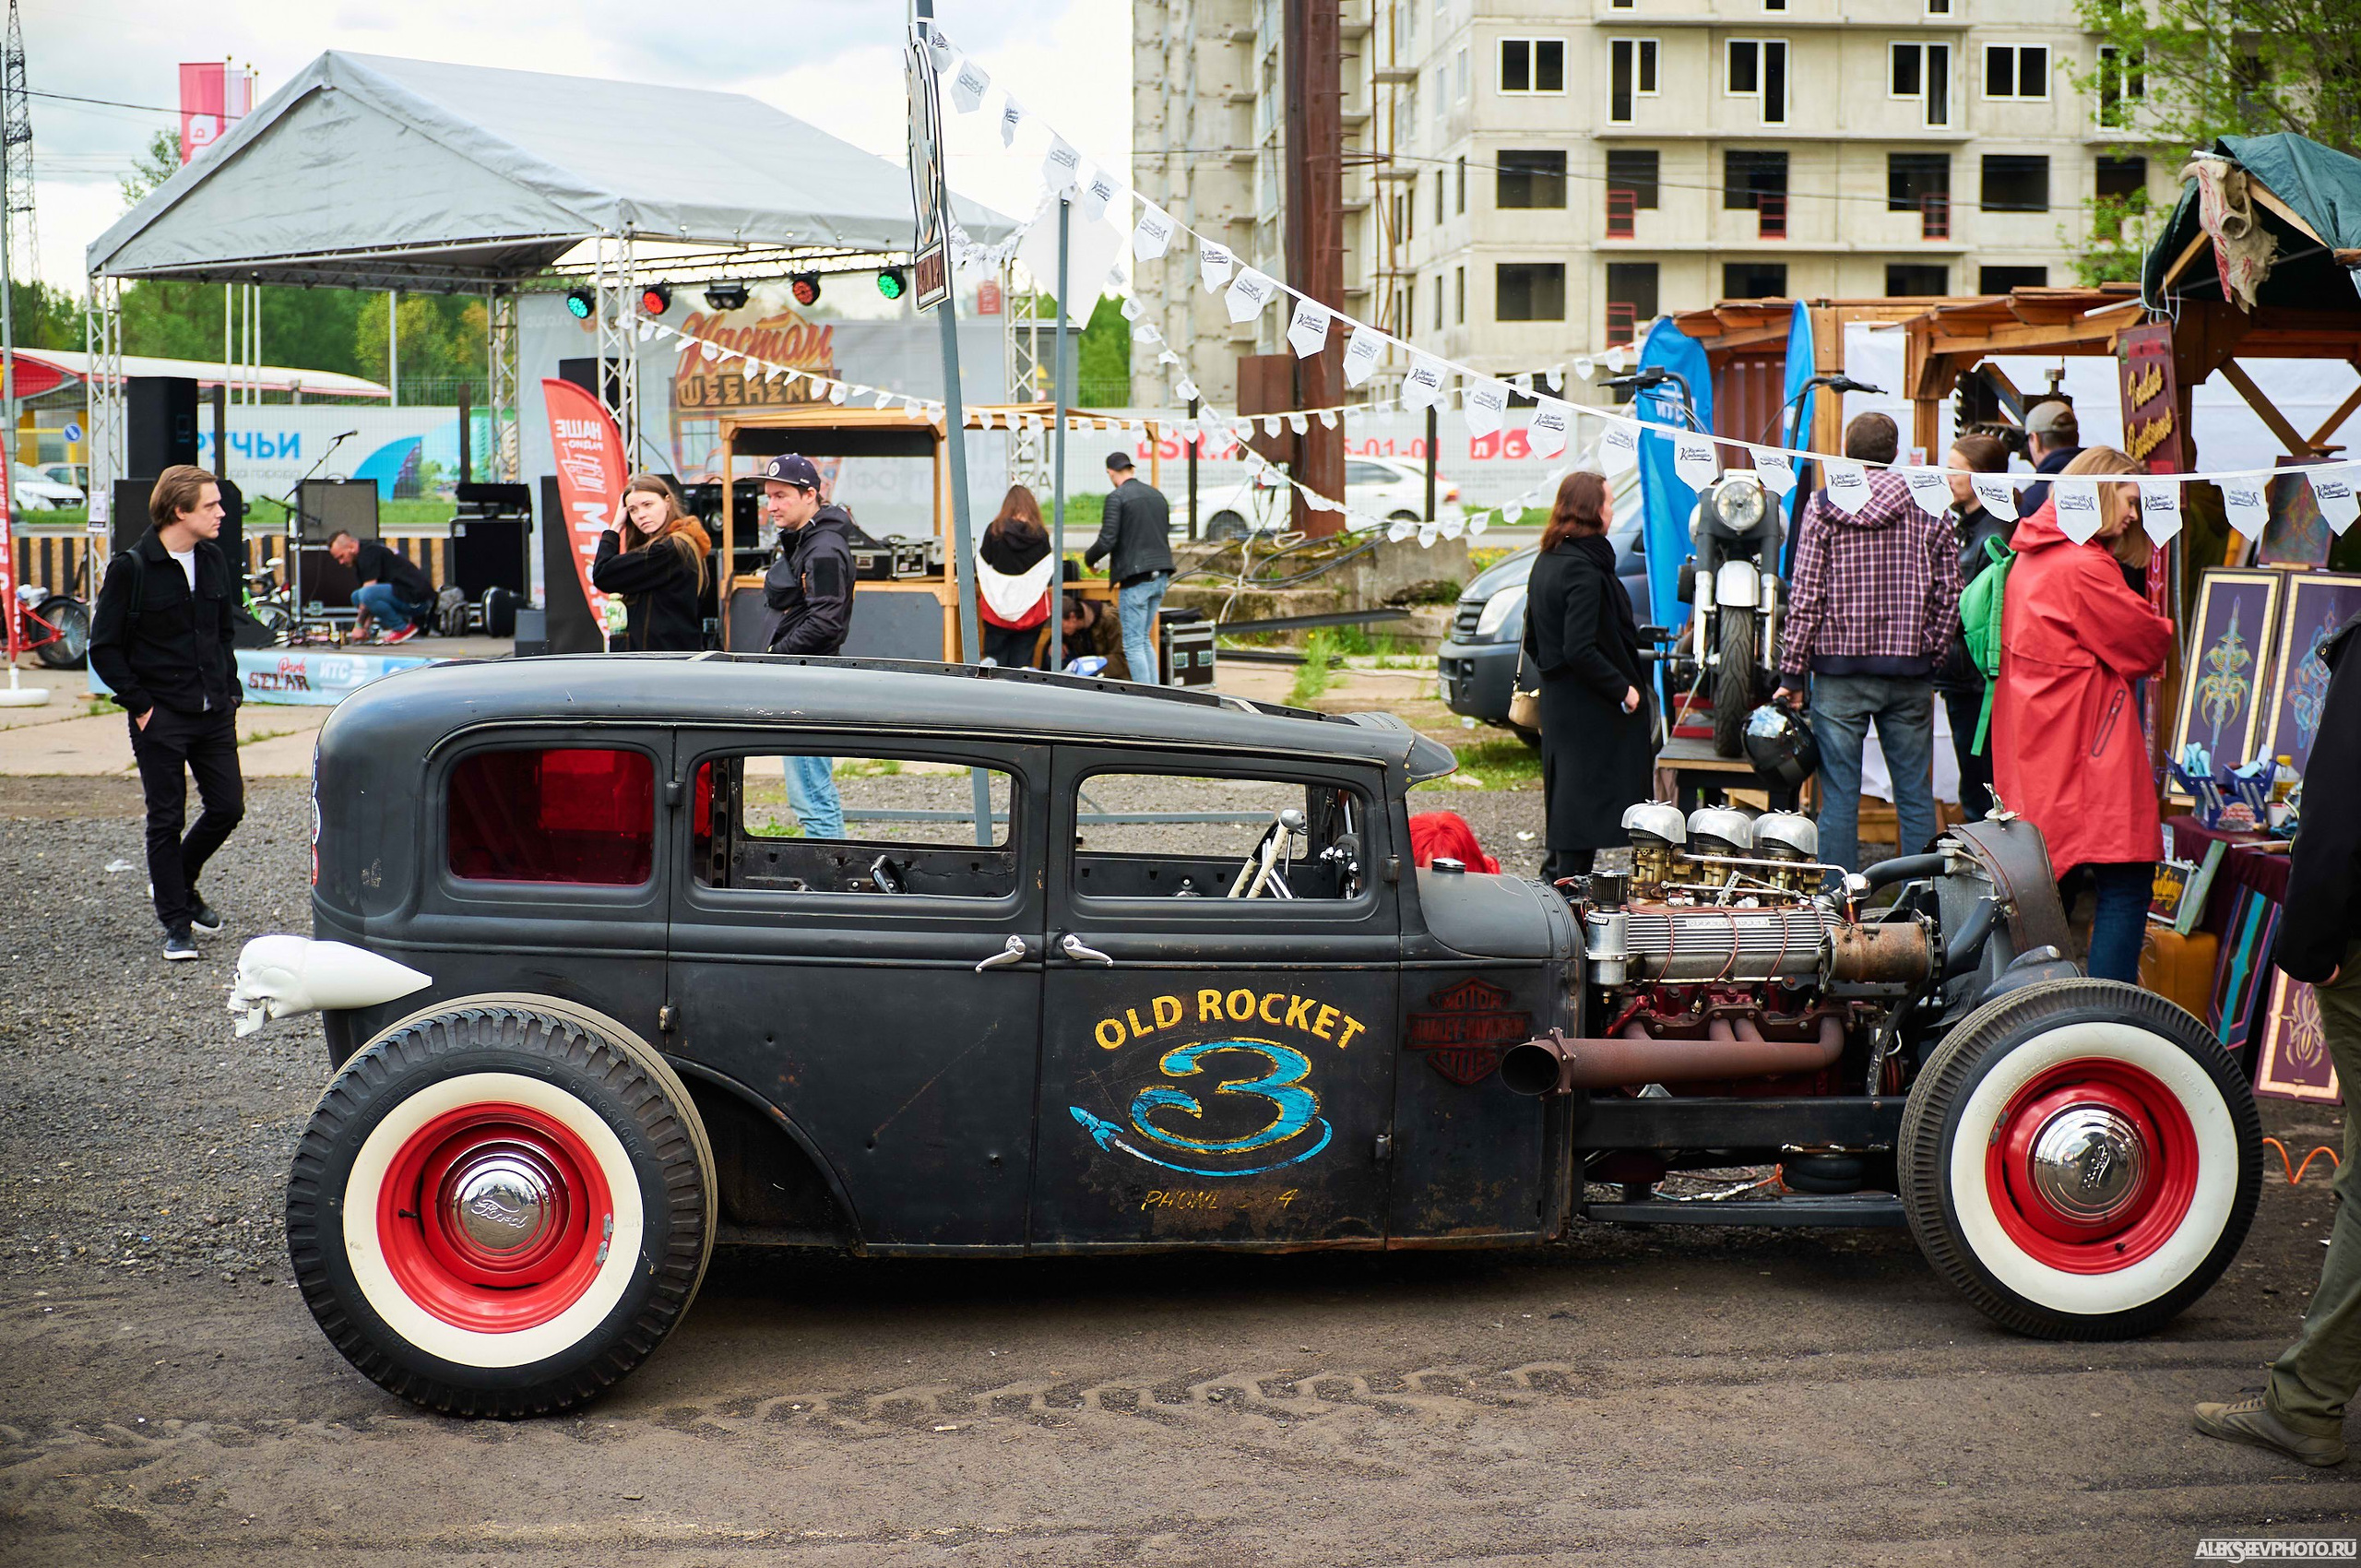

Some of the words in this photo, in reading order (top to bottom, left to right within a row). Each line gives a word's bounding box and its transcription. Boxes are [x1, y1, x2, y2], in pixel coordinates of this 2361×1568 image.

[1441, 985, 1502, 1011] MOTOR
[1095, 995, 1184, 1051] OLD
[1198, 988, 1367, 1051] ROCKET
[1411, 1017, 1526, 1041] HARLEY-DAVIDSON
[1437, 1048, 1497, 1079] CYCLES
[1129, 1037, 1322, 1155] 3
[470, 1198, 528, 1238] Ford
